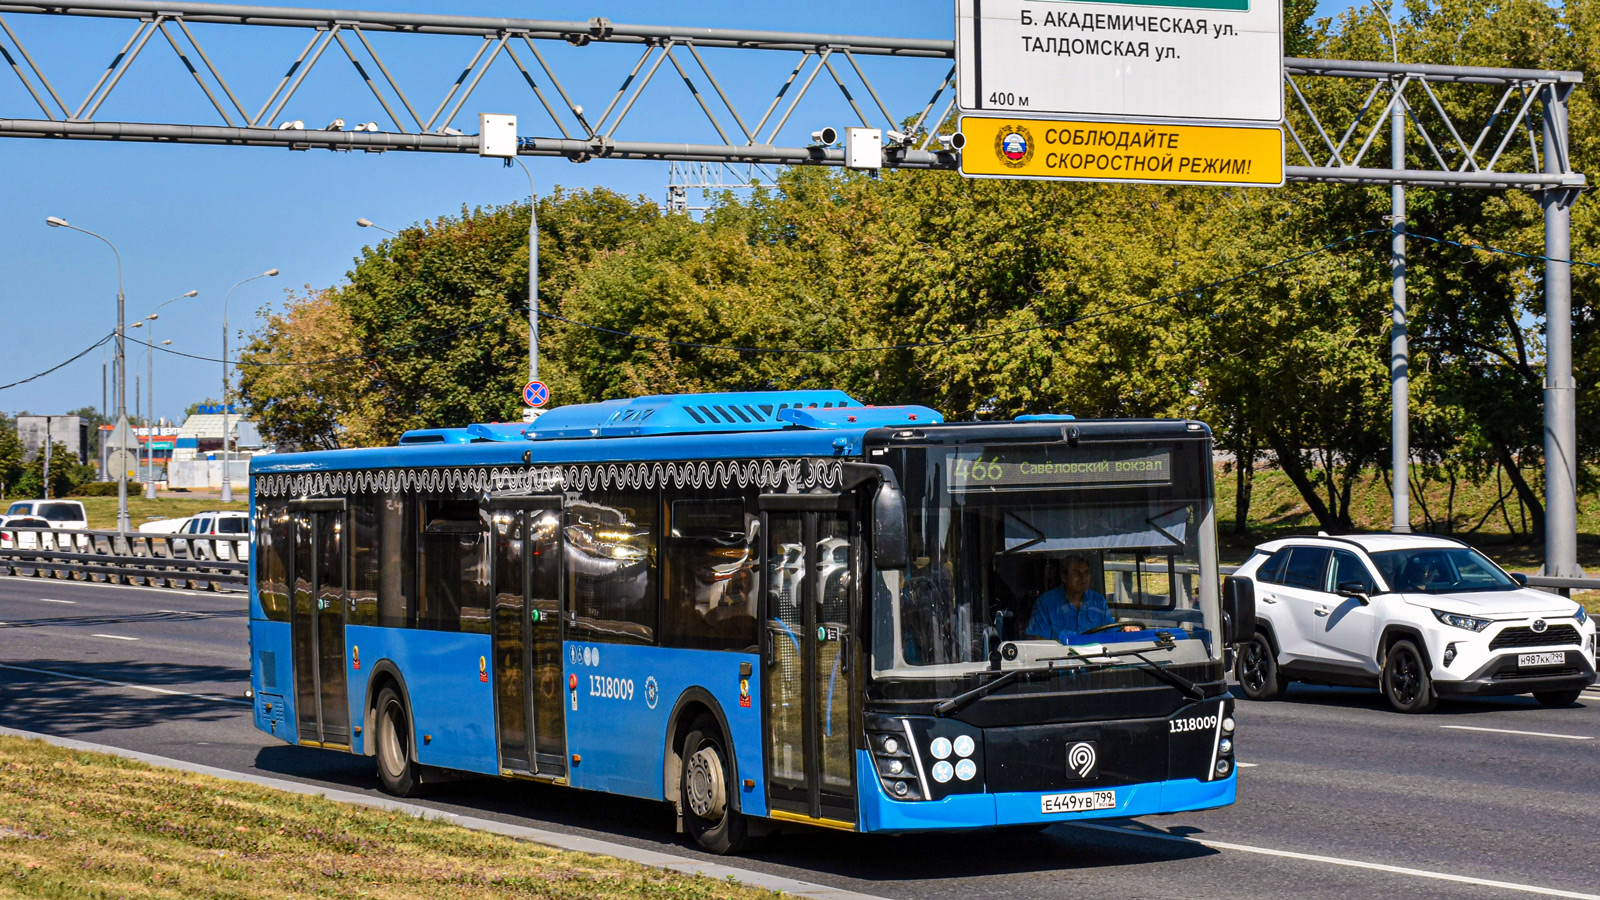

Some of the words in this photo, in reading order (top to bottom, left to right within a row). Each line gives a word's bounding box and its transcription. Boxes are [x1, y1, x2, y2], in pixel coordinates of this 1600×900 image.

[1020, 10, 1038, 27] Б.
[1044, 11, 1208, 35] АКАДЕМИЧЕСКАЯ
[1213, 22, 1239, 39] ул.
[1021, 36, 1150, 58] ТАЛДОМСКАЯ
[1155, 44, 1181, 62] ул.
[989, 92, 1015, 107] 400
[1018, 96, 1030, 107] м
[1044, 128, 1180, 150] СОБЛЮДАЙТЕ
[1045, 152, 1174, 173] СКОРОСТНОЙ
[1178, 157, 1252, 175] РЕЖИМ!
[953, 456, 1003, 481] 466
[1019, 460, 1110, 475] Савёловский
[1115, 460, 1163, 472] вокзал
[589, 674, 634, 701] 1318009
[1169, 715, 1218, 733] 1318009
[1045, 795, 1093, 811] Е449УВ
[1094, 791, 1112, 803] 799
